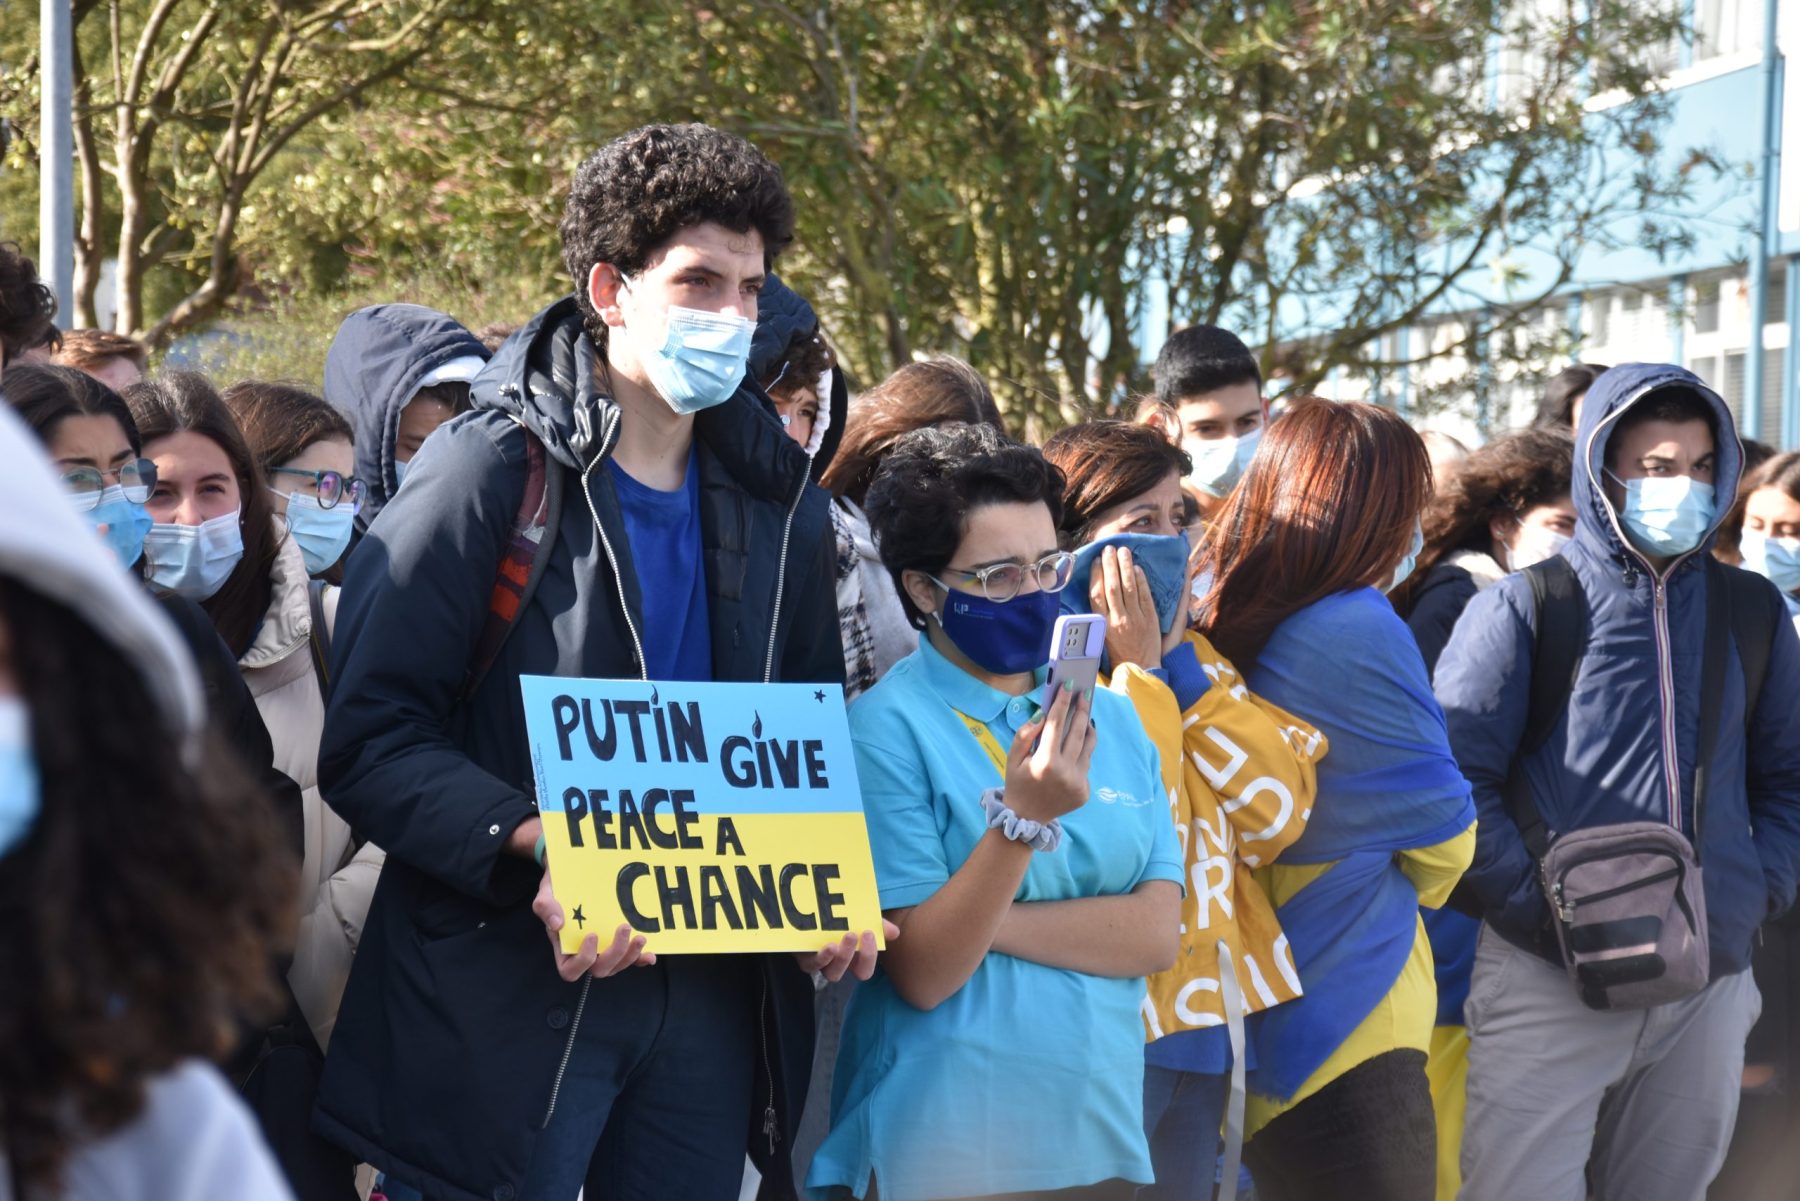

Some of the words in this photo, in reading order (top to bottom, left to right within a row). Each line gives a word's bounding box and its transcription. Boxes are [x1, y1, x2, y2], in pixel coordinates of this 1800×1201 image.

[562, 786, 704, 849] PEACE
[716, 817, 746, 856] A
[616, 861, 849, 933] CHANCE
